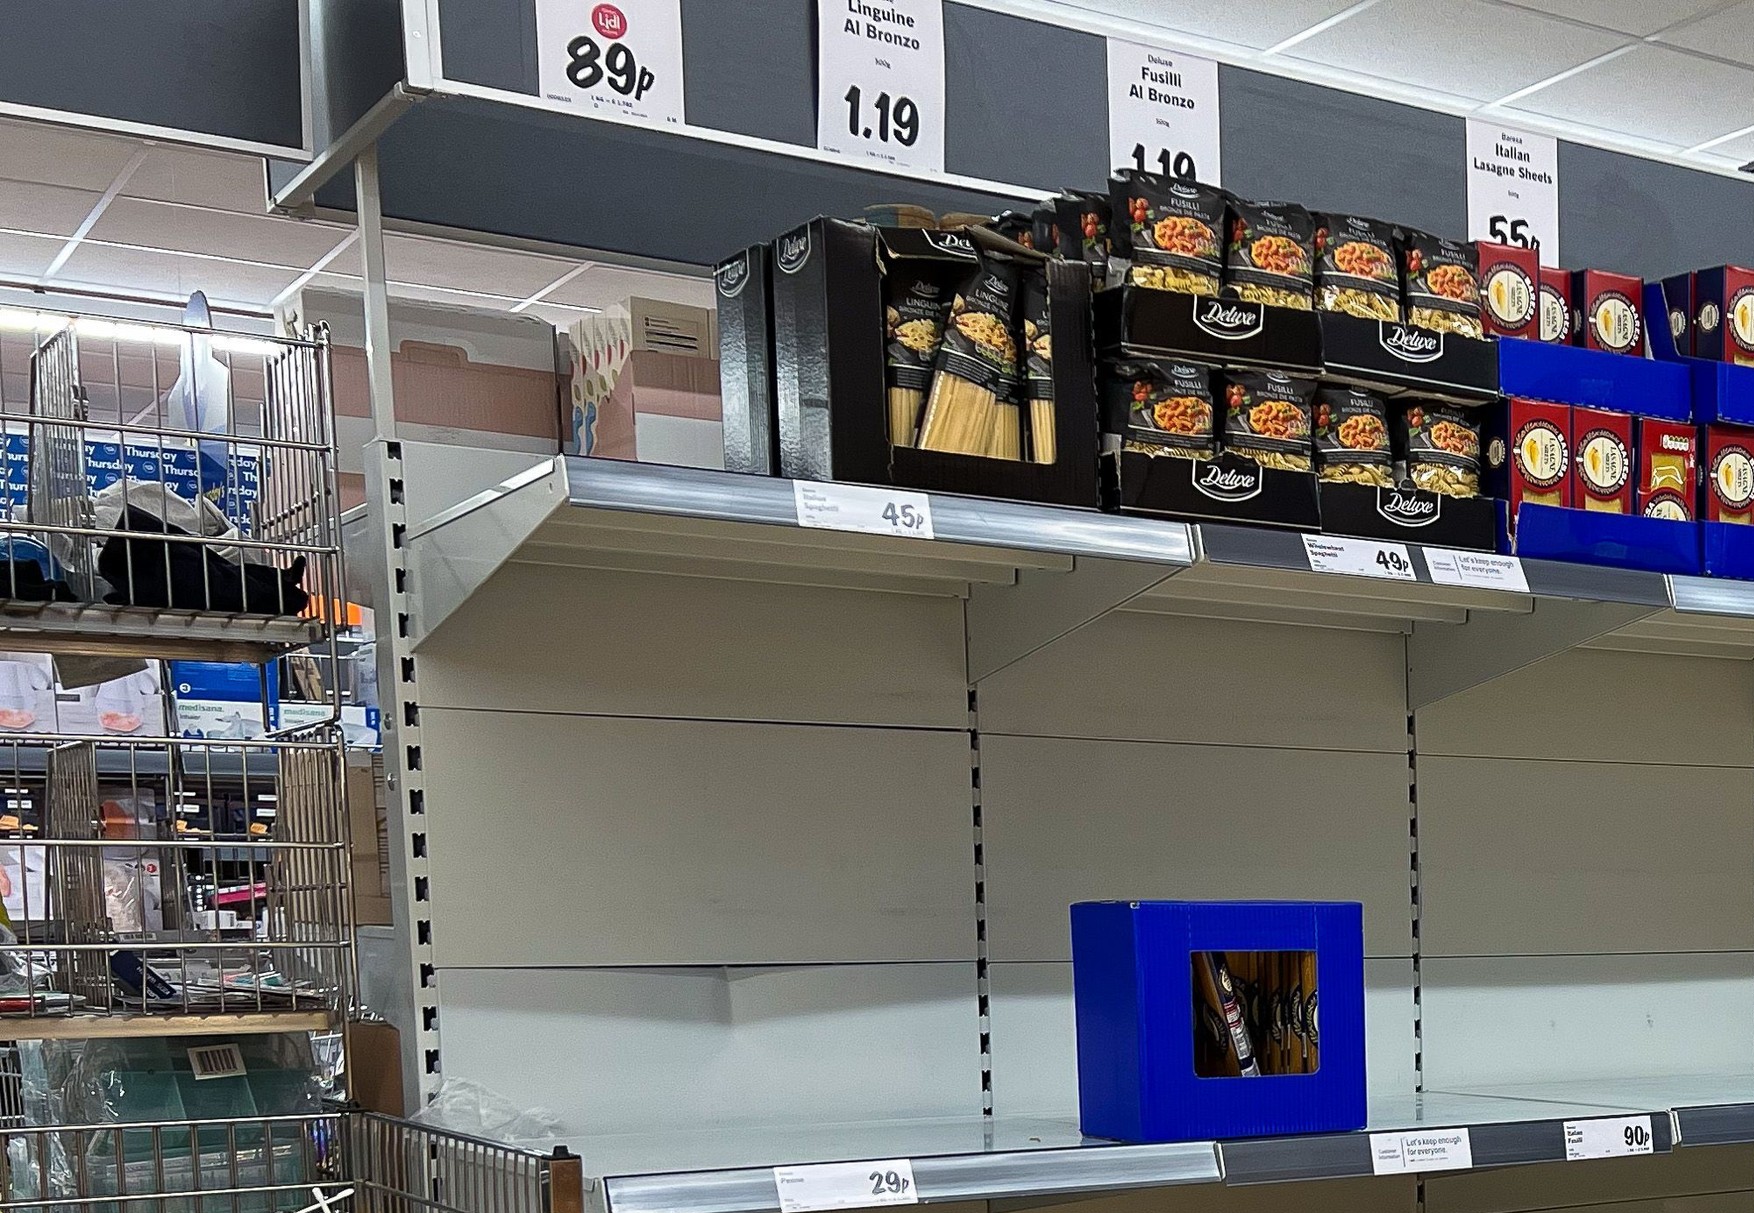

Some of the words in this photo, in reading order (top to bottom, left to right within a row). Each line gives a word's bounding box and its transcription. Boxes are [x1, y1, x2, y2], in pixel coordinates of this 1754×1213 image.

[848, 0, 915, 28] Linguine
[844, 18, 861, 36] Al
[866, 22, 920, 51] Bronzo
[566, 35, 655, 101] 89p
[1141, 66, 1182, 88] Fusilli
[1129, 83, 1143, 99] Al
[1148, 86, 1195, 109] Bronzo
[844, 84, 920, 147] 1.19
[1495, 143, 1531, 163] Italian
[1474, 156, 1515, 176] Lasagne
[1519, 166, 1553, 185] Sheets
[1201, 301, 1257, 328] Deluxe
[1387, 326, 1438, 351] Deluxe
[1557, 432, 1569, 478] BARESA
[1618, 442, 1630, 487] BARESA
[1200, 465, 1255, 490] Deluxe
[882, 502, 924, 530] 45p
[1384, 492, 1434, 515] Deluxe
[1376, 550, 1409, 573] 49p
[1624, 1125, 1650, 1146] 90p
[869, 1170, 909, 1195] 29p
